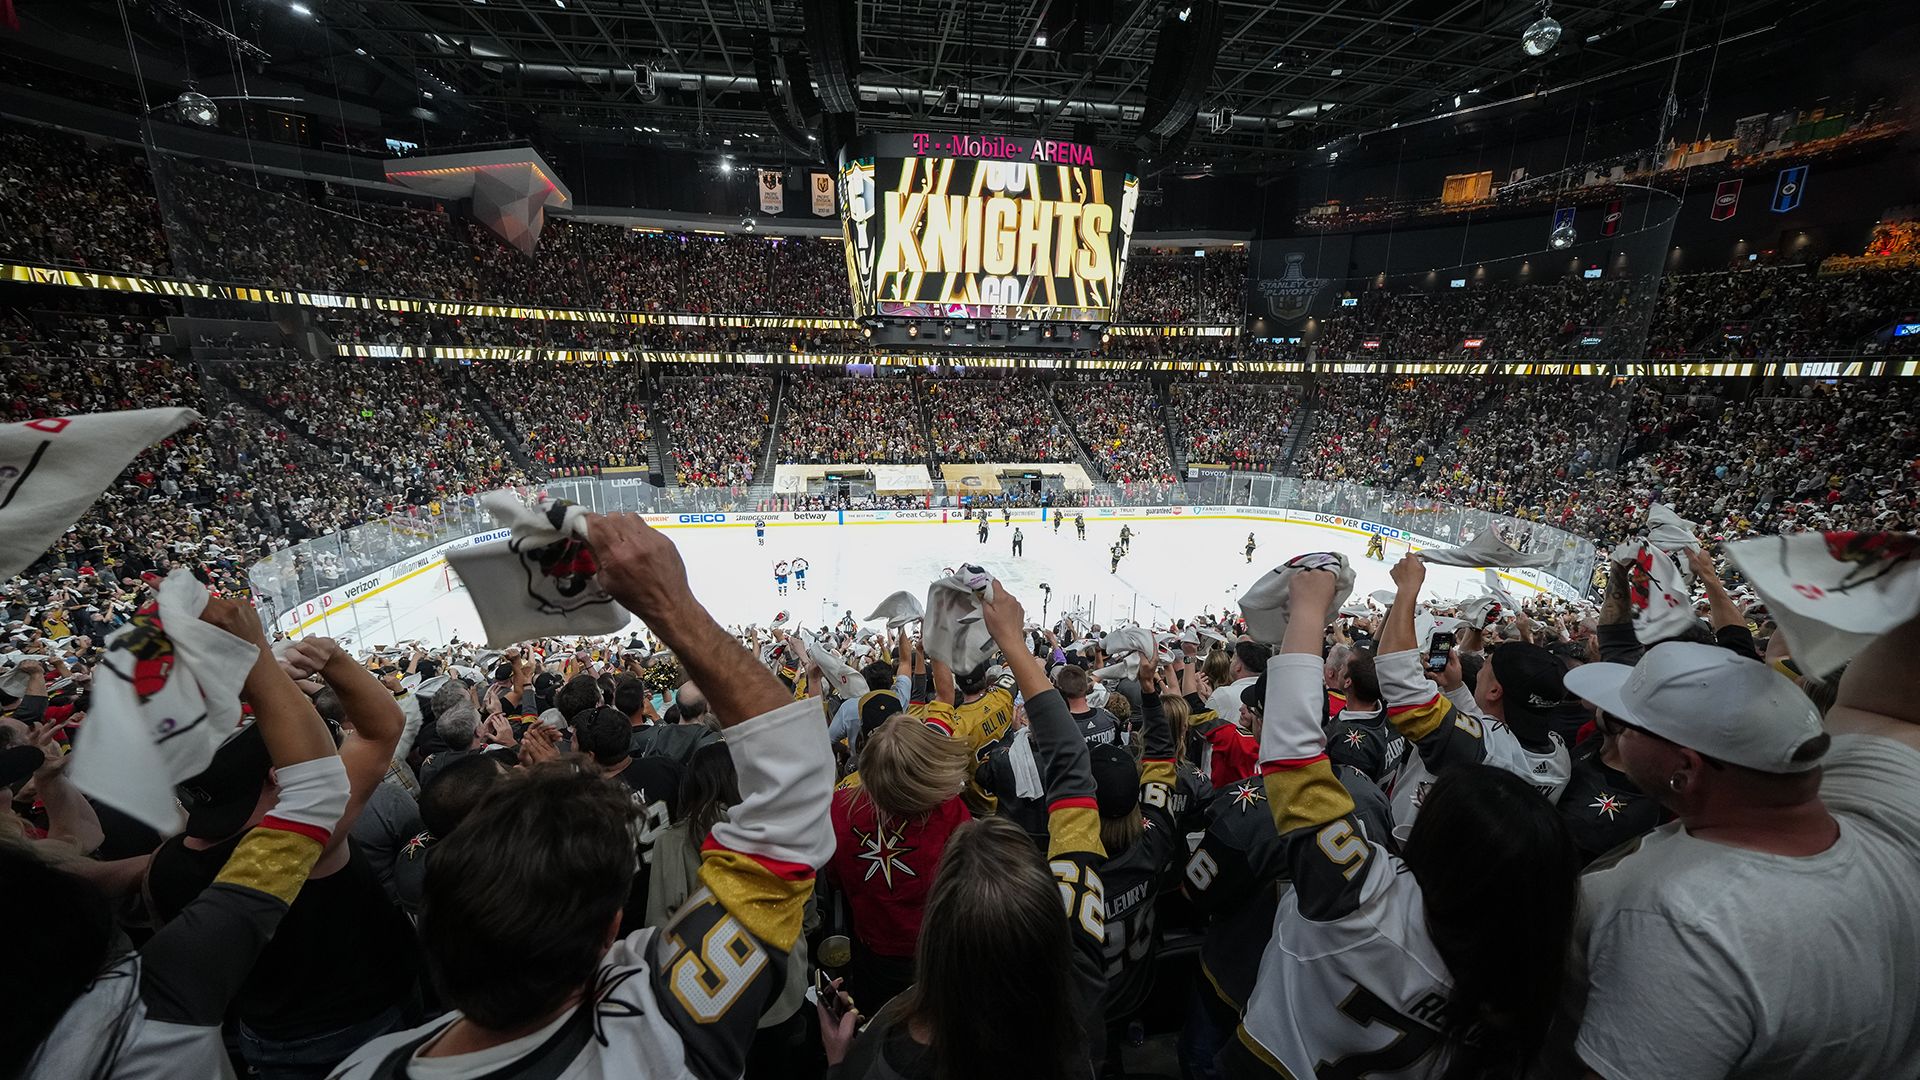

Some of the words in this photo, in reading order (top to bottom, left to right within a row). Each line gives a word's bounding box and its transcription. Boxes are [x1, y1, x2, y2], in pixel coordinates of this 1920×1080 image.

[1031, 140, 1094, 166] ARENA
[883, 191, 1113, 280] KNIGHTS
[1259, 281, 1303, 290] STANLEY
[1304, 279, 1328, 288] CUP
[1266, 288, 1318, 296] PLAYOFFS
[1800, 362, 1843, 376] GOAL
[611, 478, 642, 486] UMC
[793, 512, 827, 522] betway
[919, 511, 937, 520] Clips
[1146, 507, 1172, 516] guaranteed
[679, 514, 726, 523] GEICO
[1315, 513, 1358, 528] DISCOVER
[1360, 521, 1400, 539] GEICO
[474, 534, 492, 545] BUD
[344, 577, 379, 599] verizon
[982, 721, 998, 736] ALL
[995, 711, 1007, 724] IN
[1104, 880, 1149, 921] LEURY
